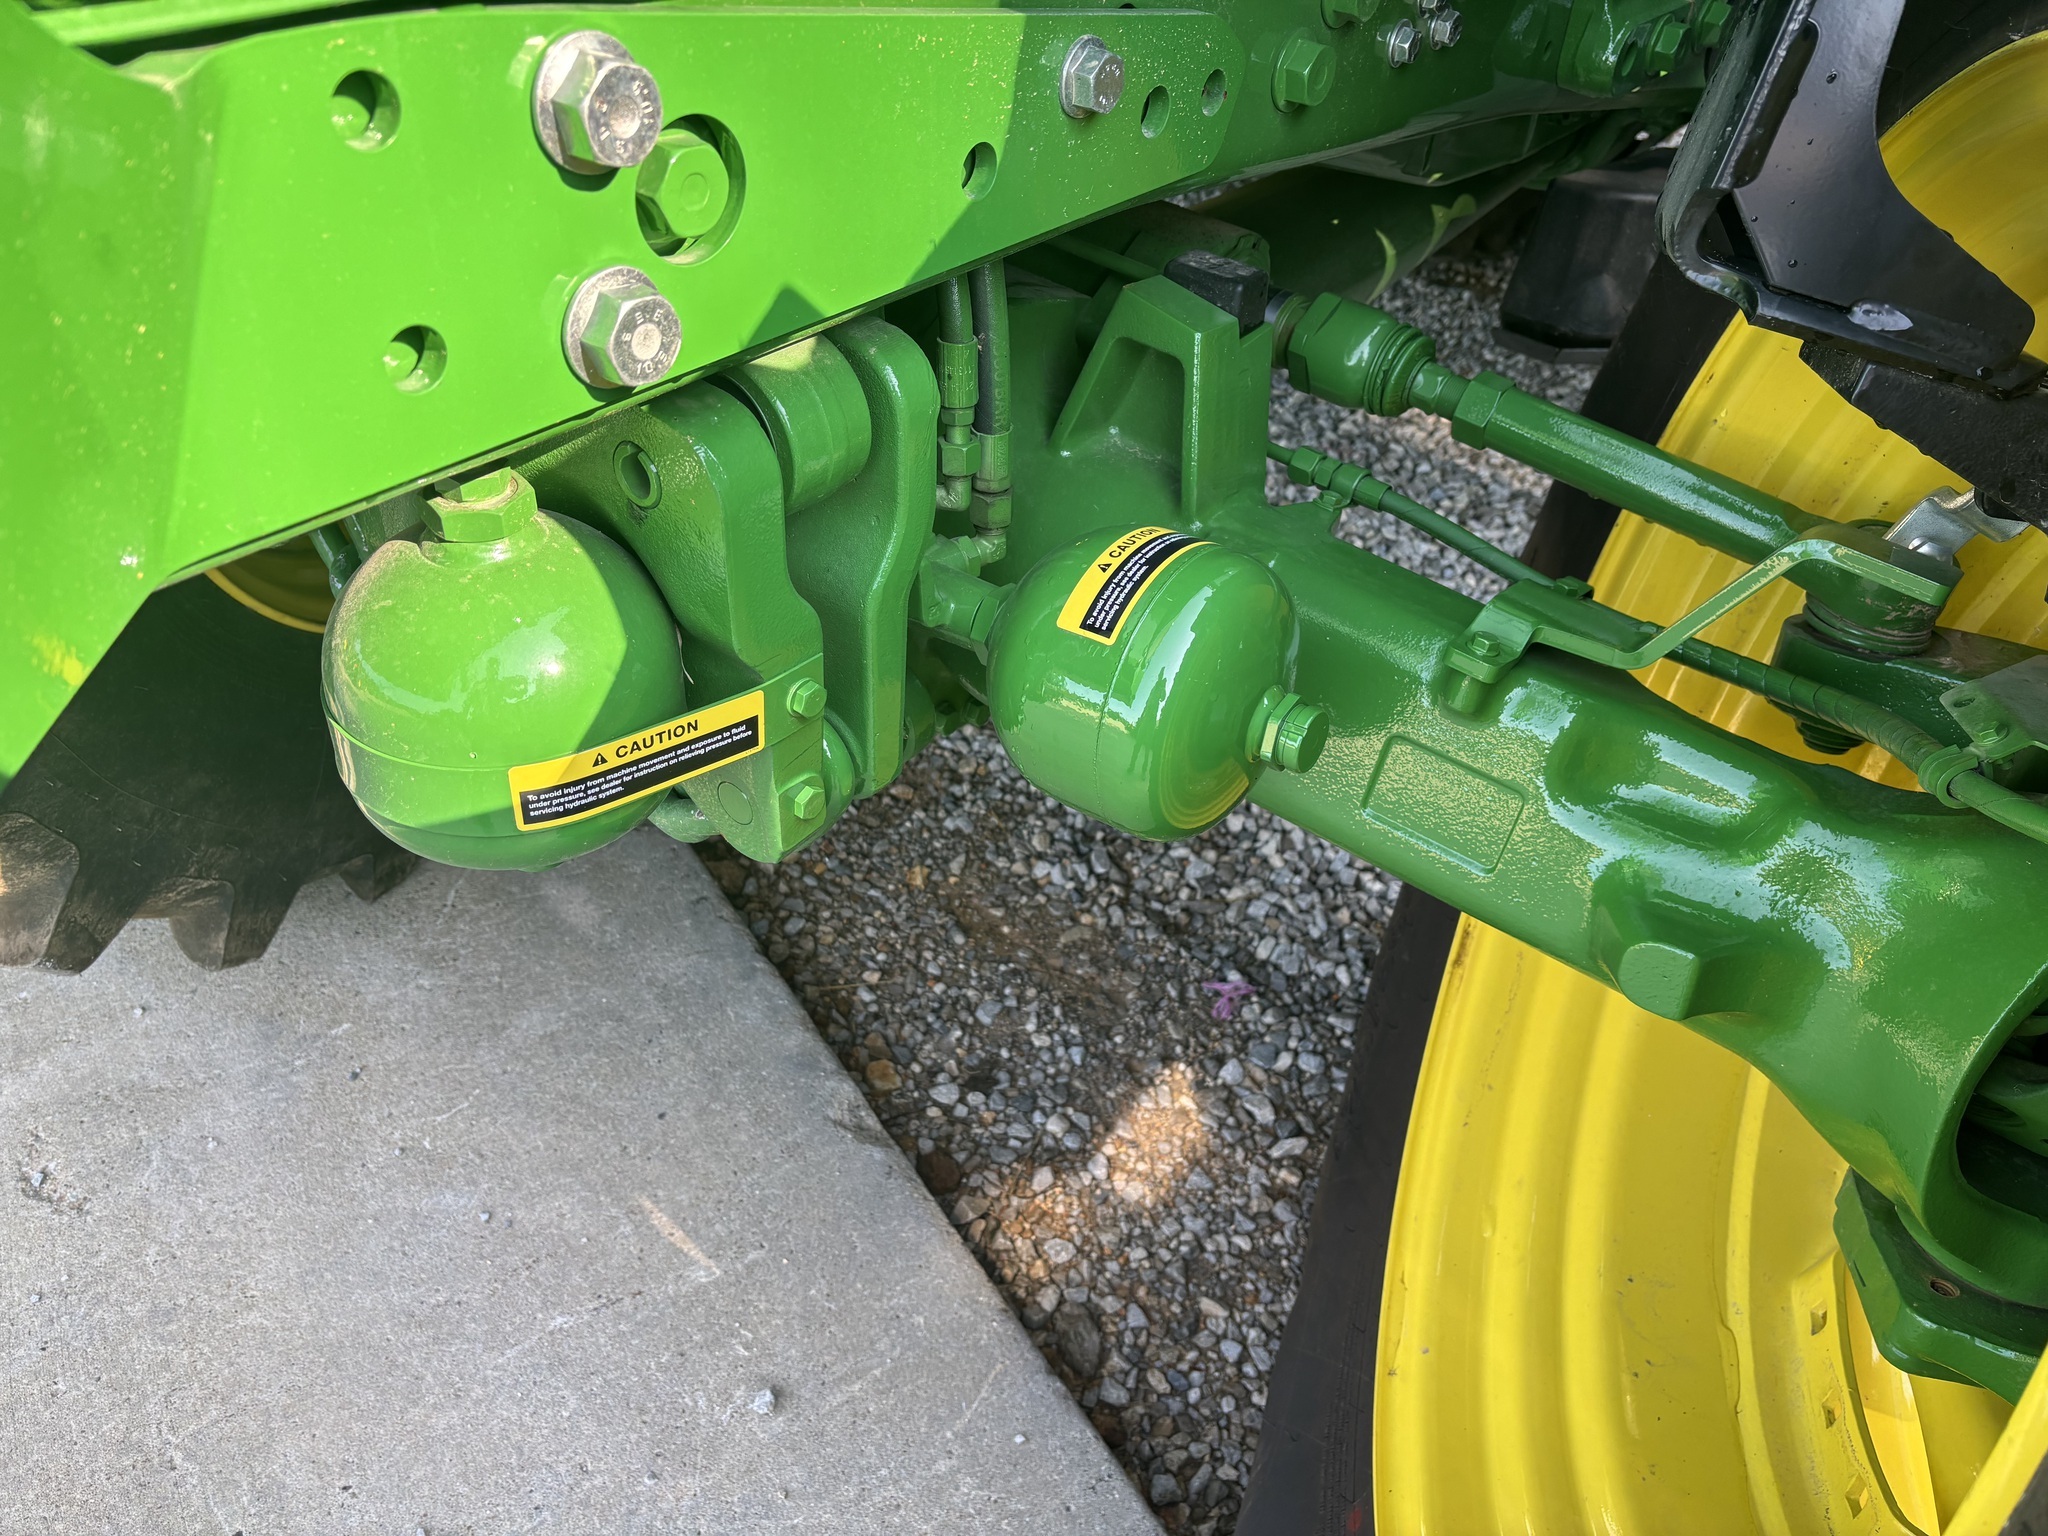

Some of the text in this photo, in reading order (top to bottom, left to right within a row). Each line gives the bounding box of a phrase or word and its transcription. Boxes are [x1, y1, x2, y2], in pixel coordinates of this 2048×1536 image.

[1109, 528, 1161, 558] CAUTION
[1086, 617, 1095, 625] To
[1092, 599, 1104, 617] avoid
[1101, 583, 1116, 599] injury
[1113, 570, 1125, 584] from
[1124, 553, 1142, 571] machine
[1094, 610, 1106, 628] under
[1104, 586, 1124, 611] pressure,
[1120, 577, 1129, 587] see
[1127, 563, 1141, 577] dealer
[1101, 565, 1149, 630] servicing hydraulic system.
[527, 794, 538, 802] To
[540, 789, 562, 800] avoid
[563, 783, 586, 795] injury
[587, 777, 605, 787] from
[607, 766, 638, 783] machine
[639, 751, 676, 769] movement
[677, 745, 690, 756] and
[691, 735, 722, 751] exposure
[731, 724, 746, 735] fluid
[529, 800, 551, 809] under
[552, 792, 587, 806] pressure,
[587, 787, 600, 795] see
[601, 779, 622, 790] dealer
[623, 774, 634, 783] for
[634, 762, 668, 779] instruction
[669, 758, 678, 766] on
[678, 748, 705, 762] relieving
[705, 738, 732, 753] pressure
[733, 730, 752, 742] before
[615, 719, 698, 758] CAUTION
[530, 785, 625, 817] servicing hydraulic system.
